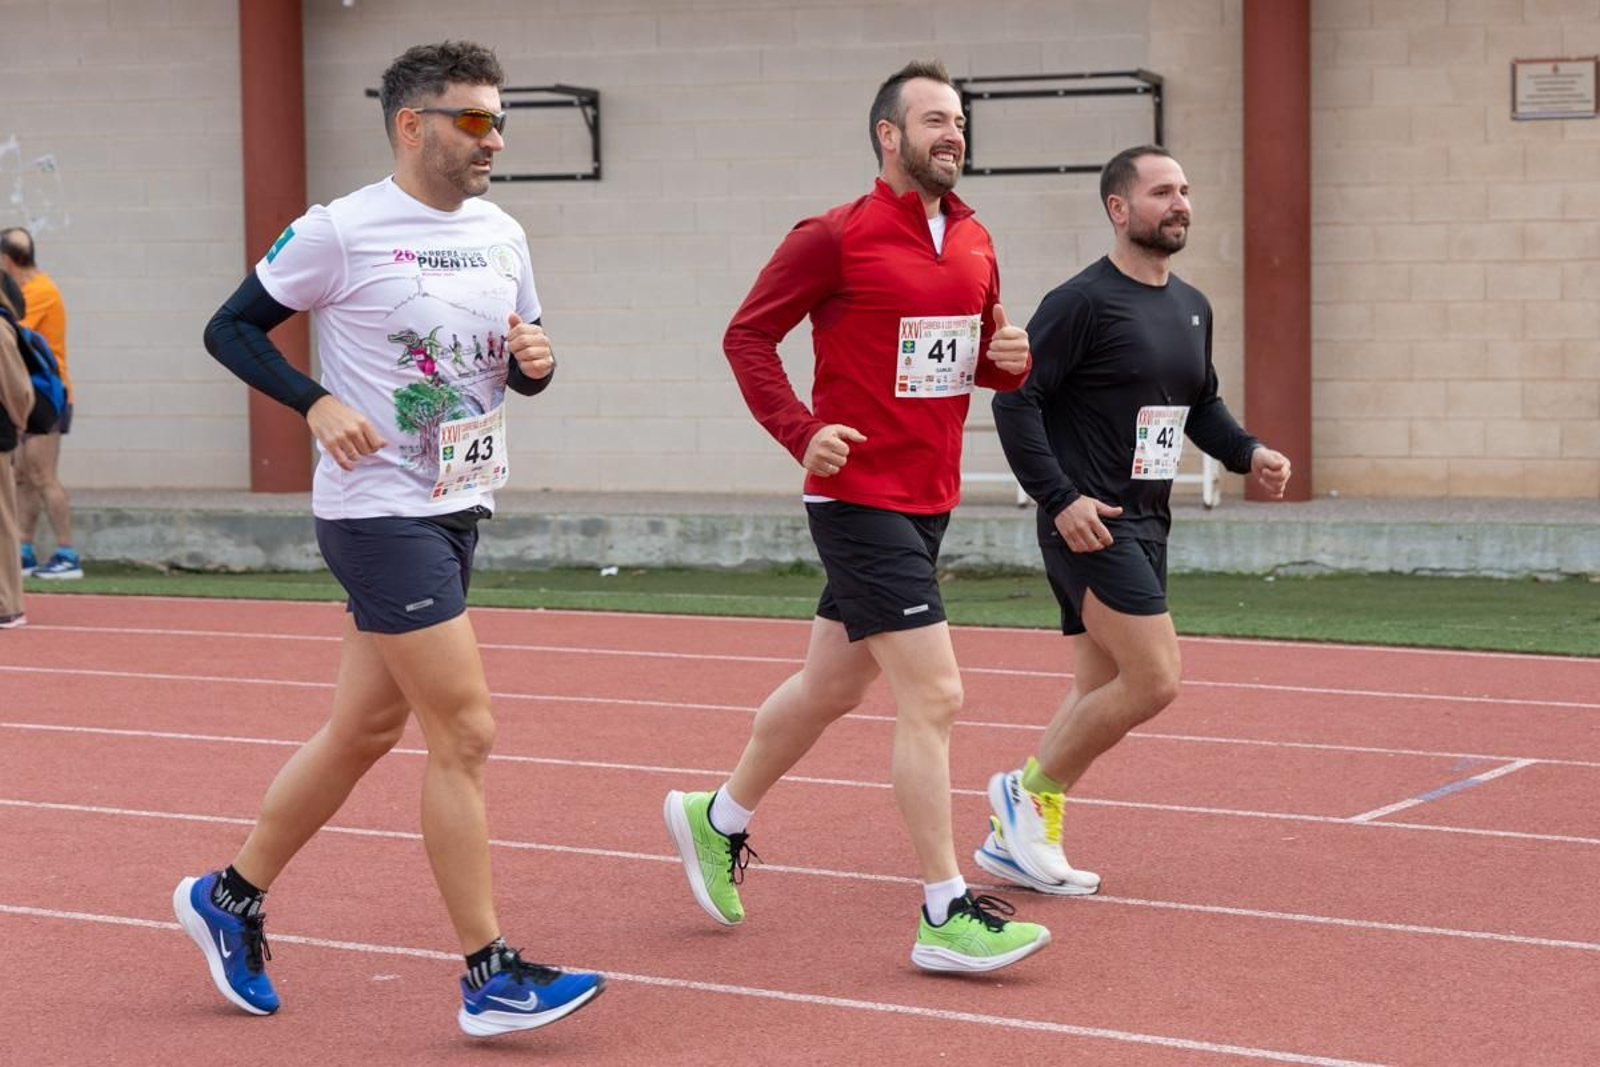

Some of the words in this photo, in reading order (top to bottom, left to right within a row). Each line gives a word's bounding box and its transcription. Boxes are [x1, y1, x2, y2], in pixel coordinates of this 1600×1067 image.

[393, 249, 416, 261] 26
[417, 256, 487, 268] PUENTES
[901, 320, 921, 339] XXVI
[928, 338, 956, 363] 41
[441, 424, 461, 446] XXVI
[1156, 427, 1173, 448] 42
[464, 434, 494, 464] 43
